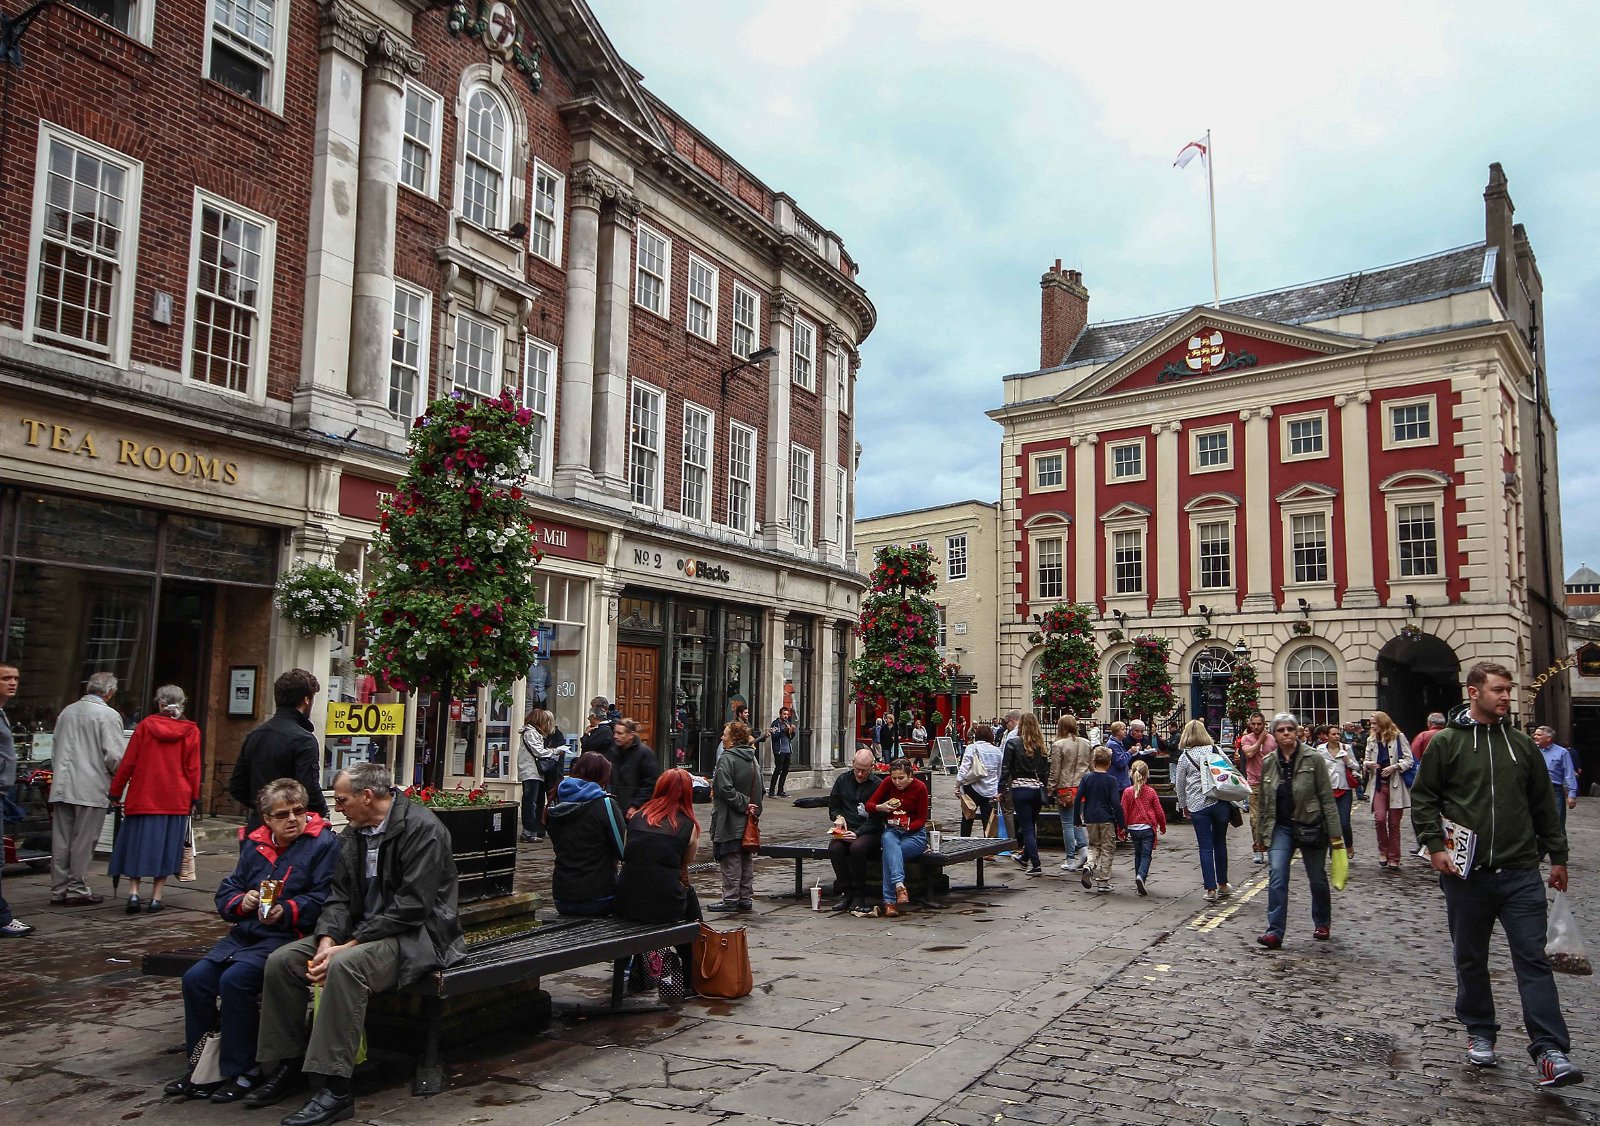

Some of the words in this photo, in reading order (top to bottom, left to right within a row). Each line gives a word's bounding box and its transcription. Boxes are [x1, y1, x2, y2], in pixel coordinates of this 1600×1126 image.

[22, 418, 100, 458] TEA
[118, 438, 239, 485] ROOMS
[542, 527, 567, 547] Mill
[654, 553, 662, 569] 2
[695, 560, 730, 582] Blacks
[556, 681, 576, 697] £30
[335, 710, 346, 719] UP
[334, 720, 345, 729] TO
[380, 722, 397, 731] OFF
[1455, 830, 1470, 876] ITALY
